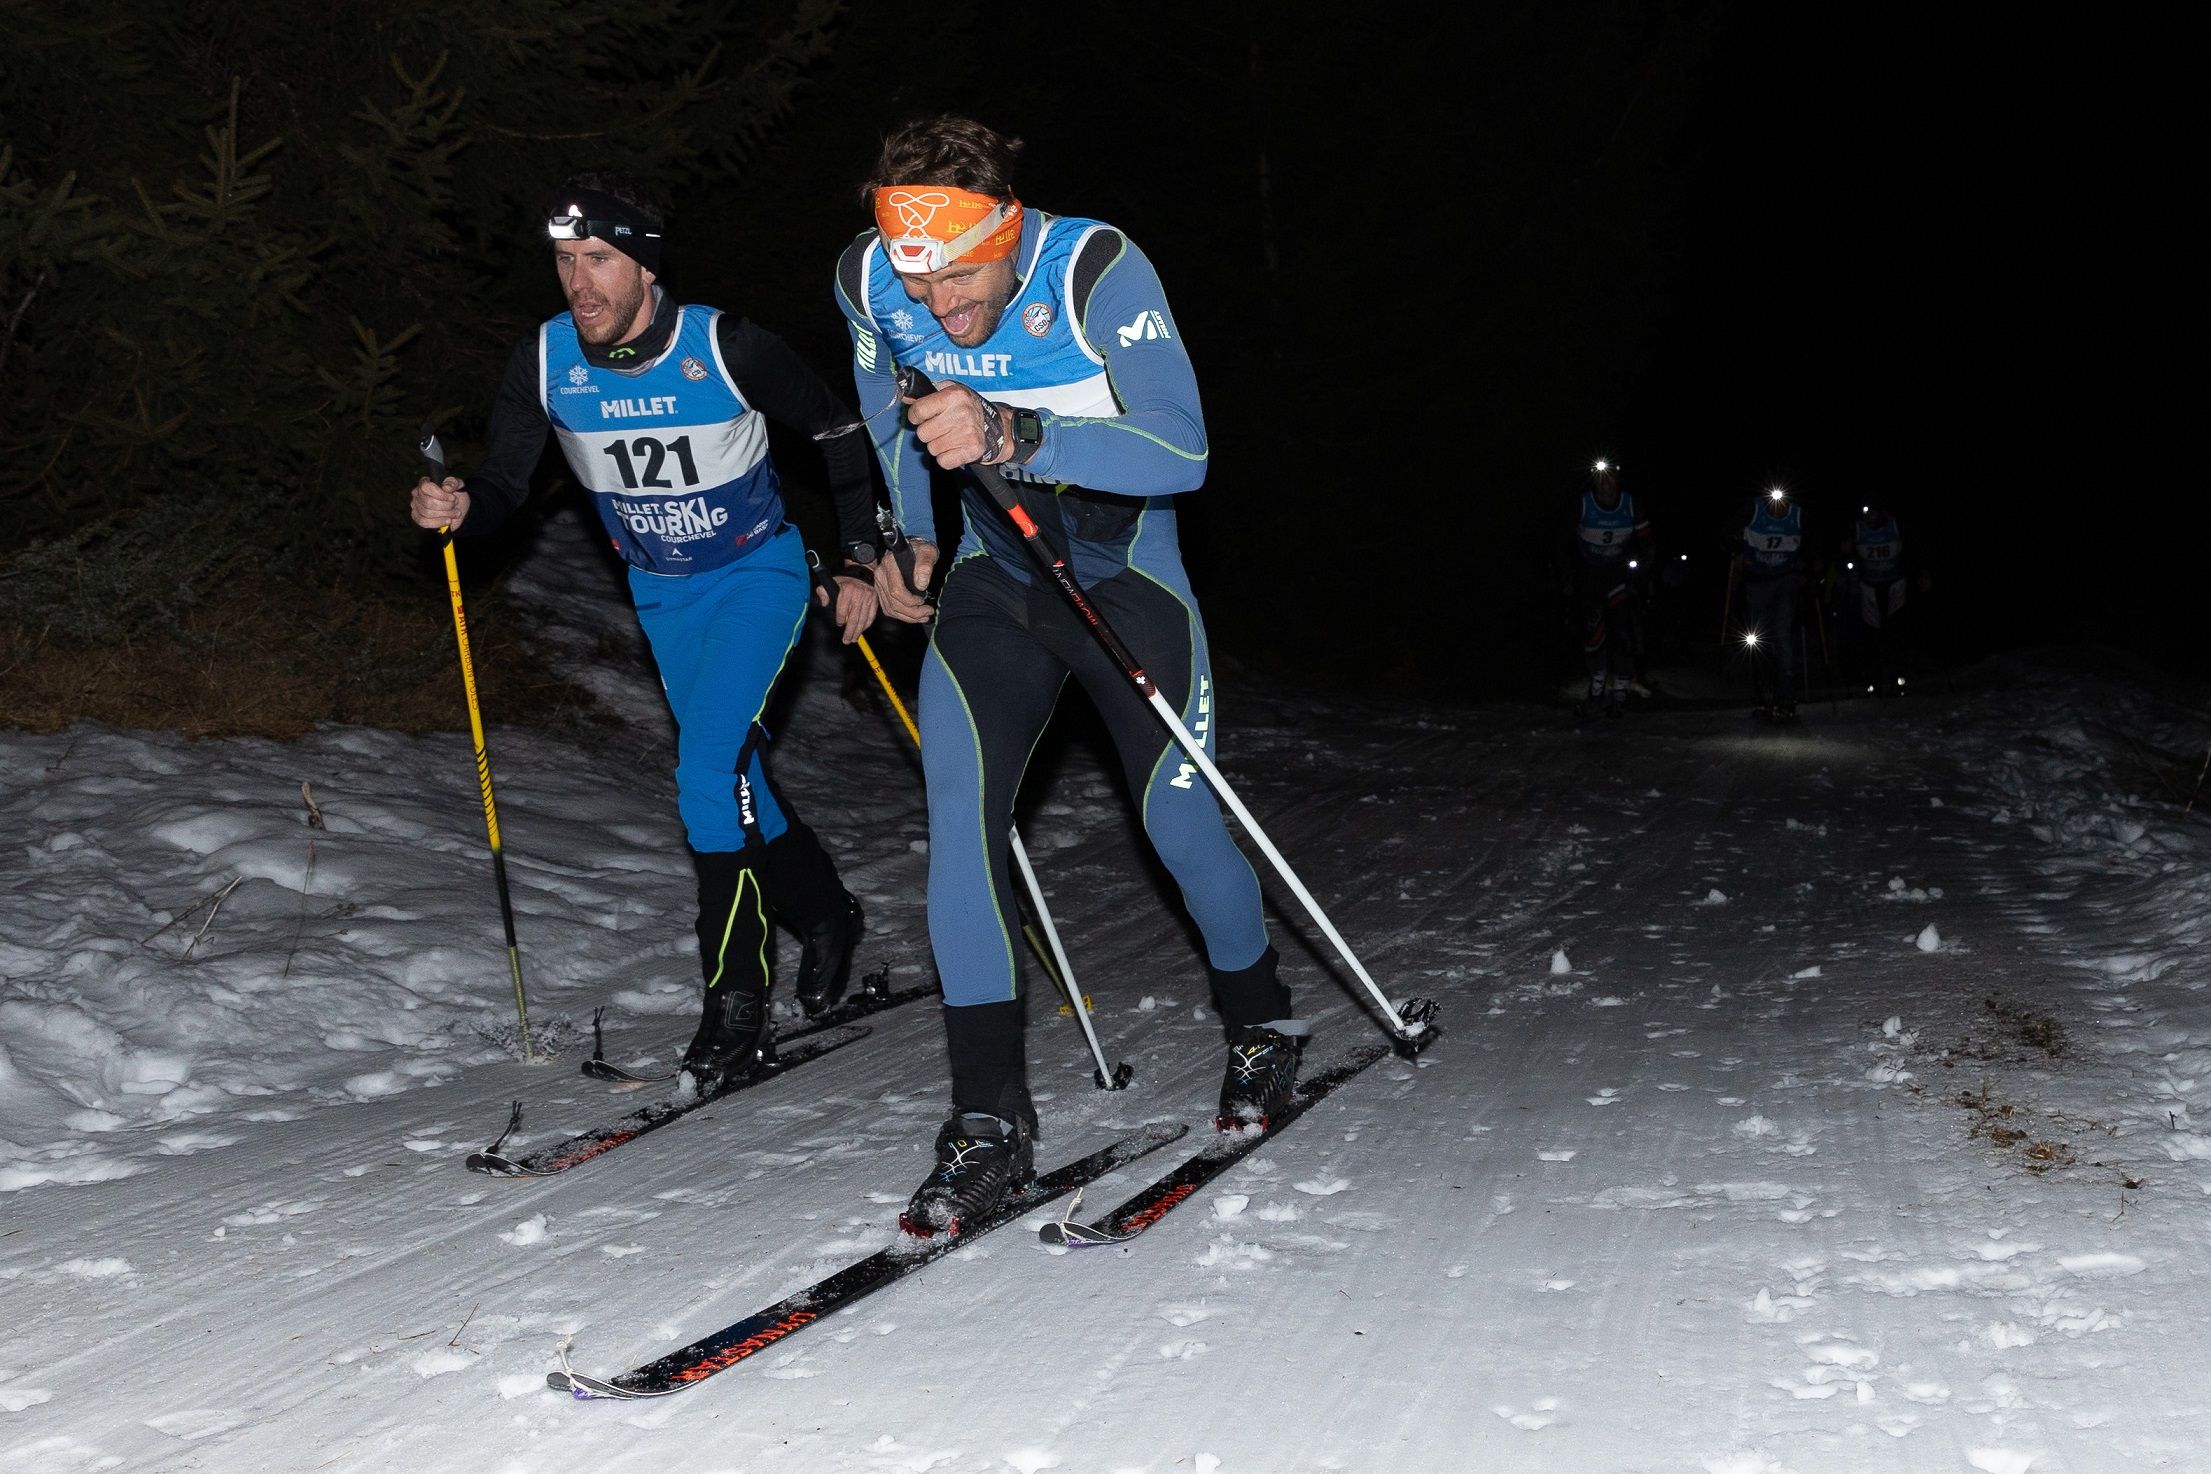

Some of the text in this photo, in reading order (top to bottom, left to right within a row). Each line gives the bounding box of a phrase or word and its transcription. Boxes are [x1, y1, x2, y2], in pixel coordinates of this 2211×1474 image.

[615, 226, 632, 236] PETZL
[925, 350, 1012, 377] MILLET
[560, 385, 600, 395] COURCHEVEL
[601, 396, 676, 418] MILLET
[603, 435, 700, 489] 121
[612, 496, 709, 522] MILLET SKI
[616, 507, 728, 538] TOURING
[661, 530, 717, 544] COURCHEVEL
[1603, 531, 1613, 544] 3
[1767, 536, 1782, 549] 17
[1169, 674, 1210, 790] MLLET
